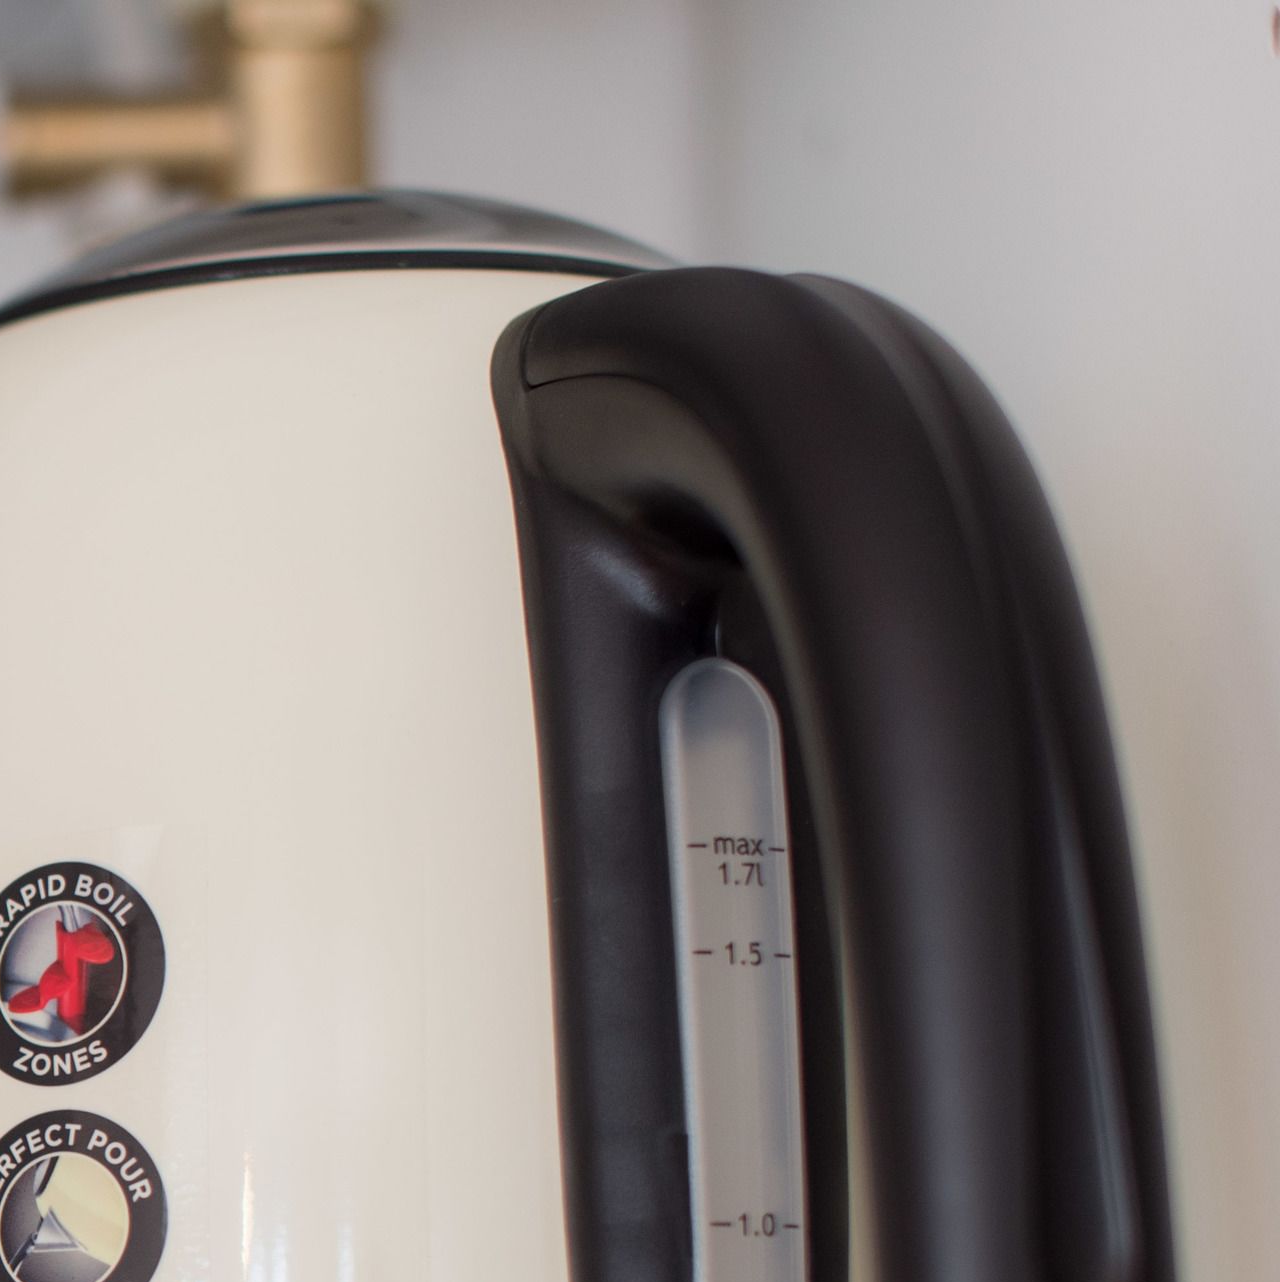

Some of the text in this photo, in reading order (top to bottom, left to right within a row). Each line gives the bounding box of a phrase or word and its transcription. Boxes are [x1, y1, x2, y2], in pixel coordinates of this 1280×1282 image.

[713, 836, 764, 857] max
[74, 874, 134, 927] BOIL
[725, 941, 762, 967] 1.5
[12, 1039, 109, 1077] ZONES
[86, 1129, 153, 1203] POUR
[738, 1212, 776, 1237] 1.0
